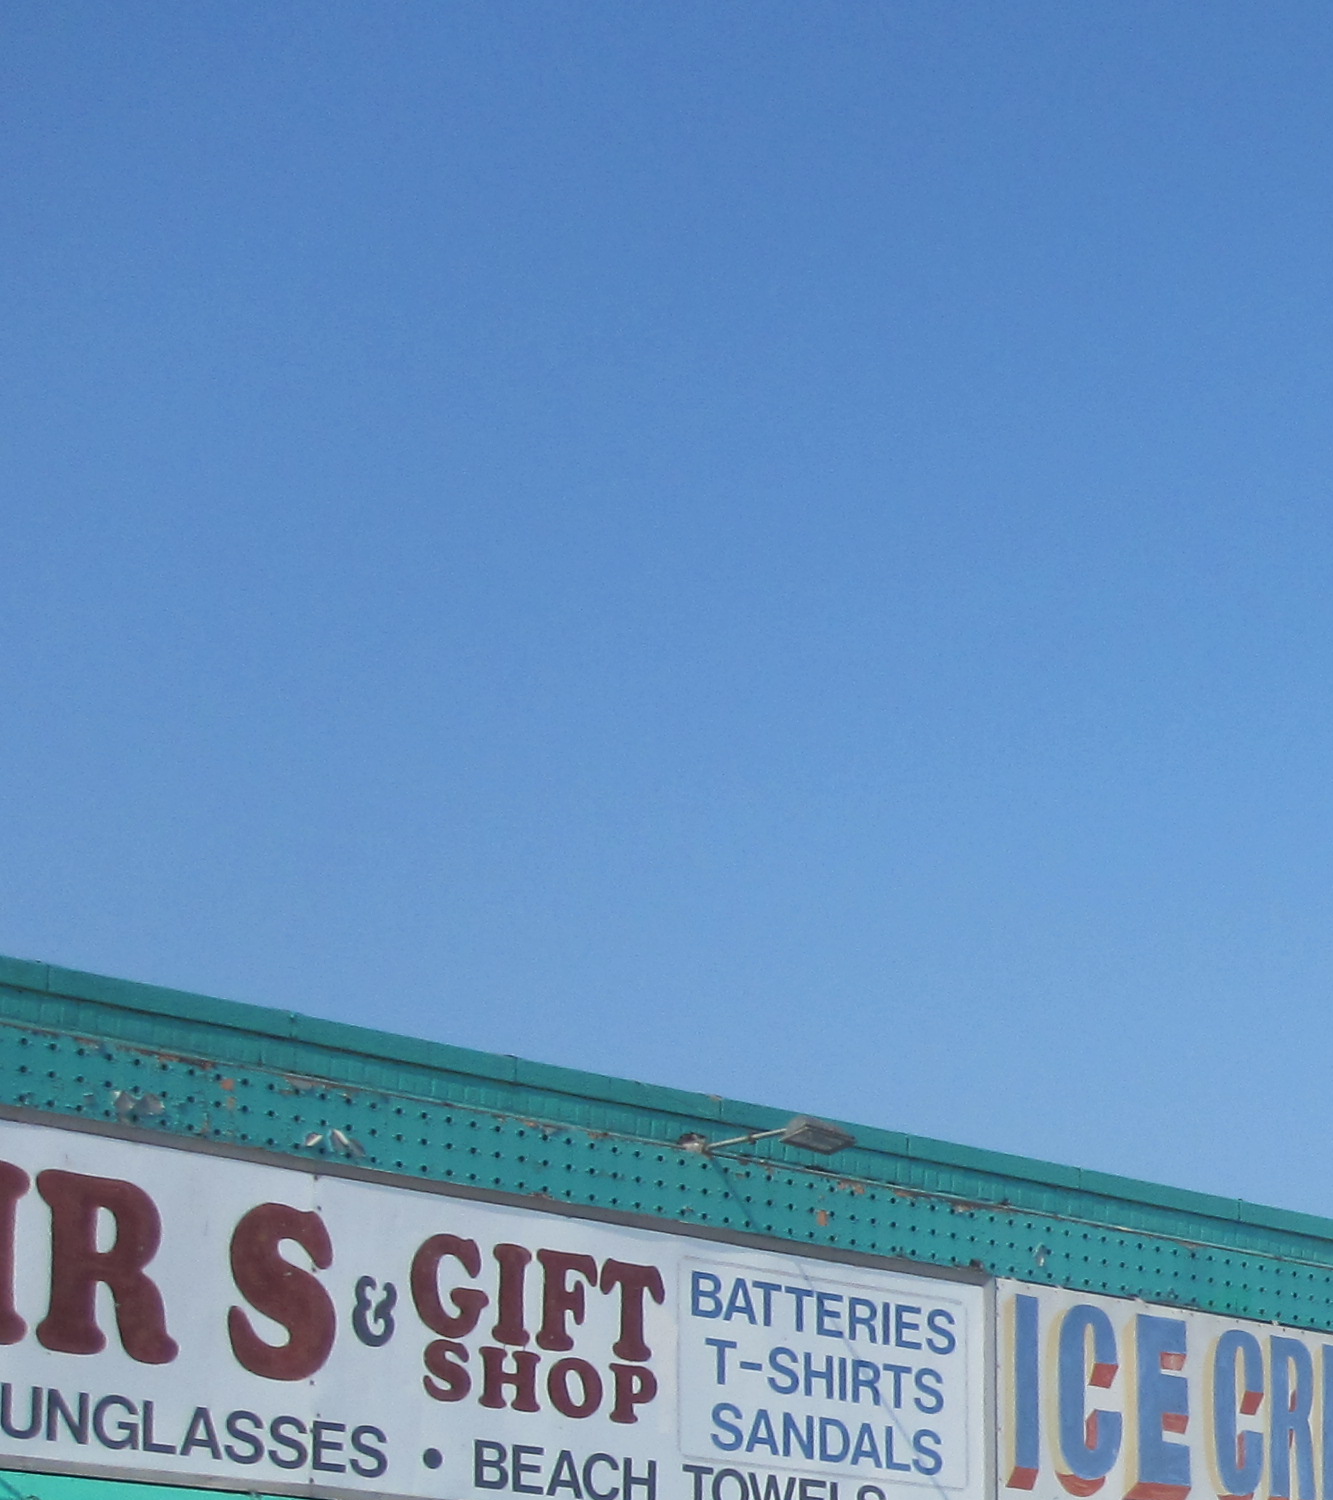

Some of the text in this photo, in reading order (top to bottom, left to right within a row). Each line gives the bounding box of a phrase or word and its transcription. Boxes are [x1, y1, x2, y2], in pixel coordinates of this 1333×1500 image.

[352, 1276, 397, 1347] &
[410, 1234, 665, 1362] GIFT
[691, 1270, 956, 1356] BATTERIES
[423, 1339, 659, 1424] SHOP
[705, 1338, 944, 1415] T-SHIRTS
[712, 1404, 943, 1476] SANDALS
